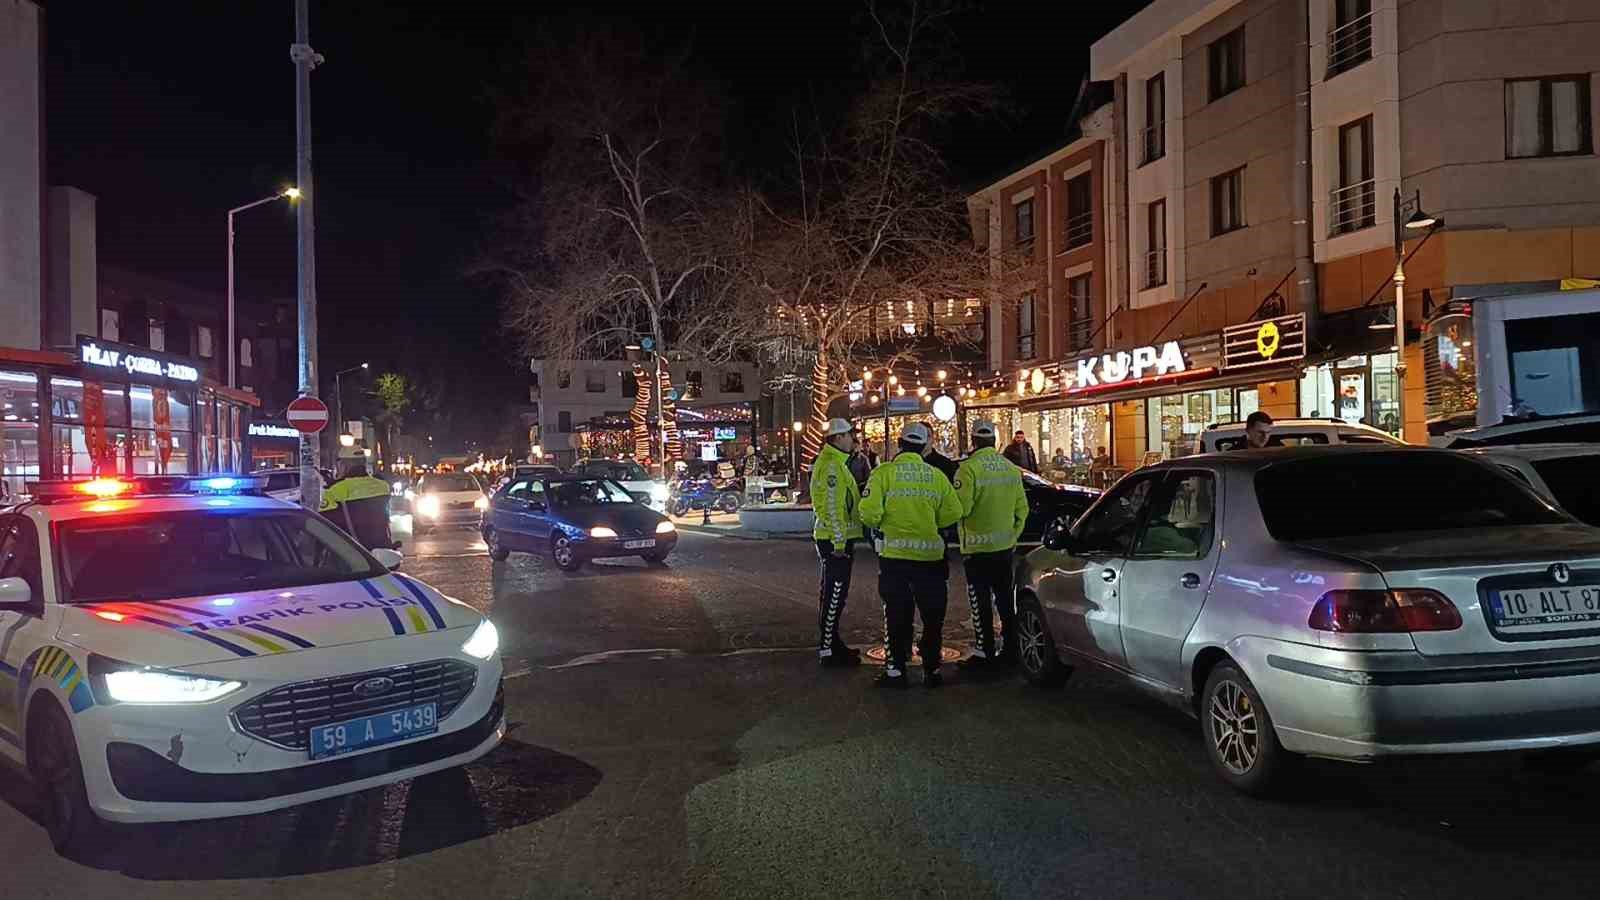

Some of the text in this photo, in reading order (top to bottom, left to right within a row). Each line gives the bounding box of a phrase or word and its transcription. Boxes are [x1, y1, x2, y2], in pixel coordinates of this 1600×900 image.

[1077, 341, 1187, 388] KUPA
[1504, 593, 1528, 616] 10
[1540, 590, 1573, 614] ALT
[323, 705, 434, 750] 59 A 5439
